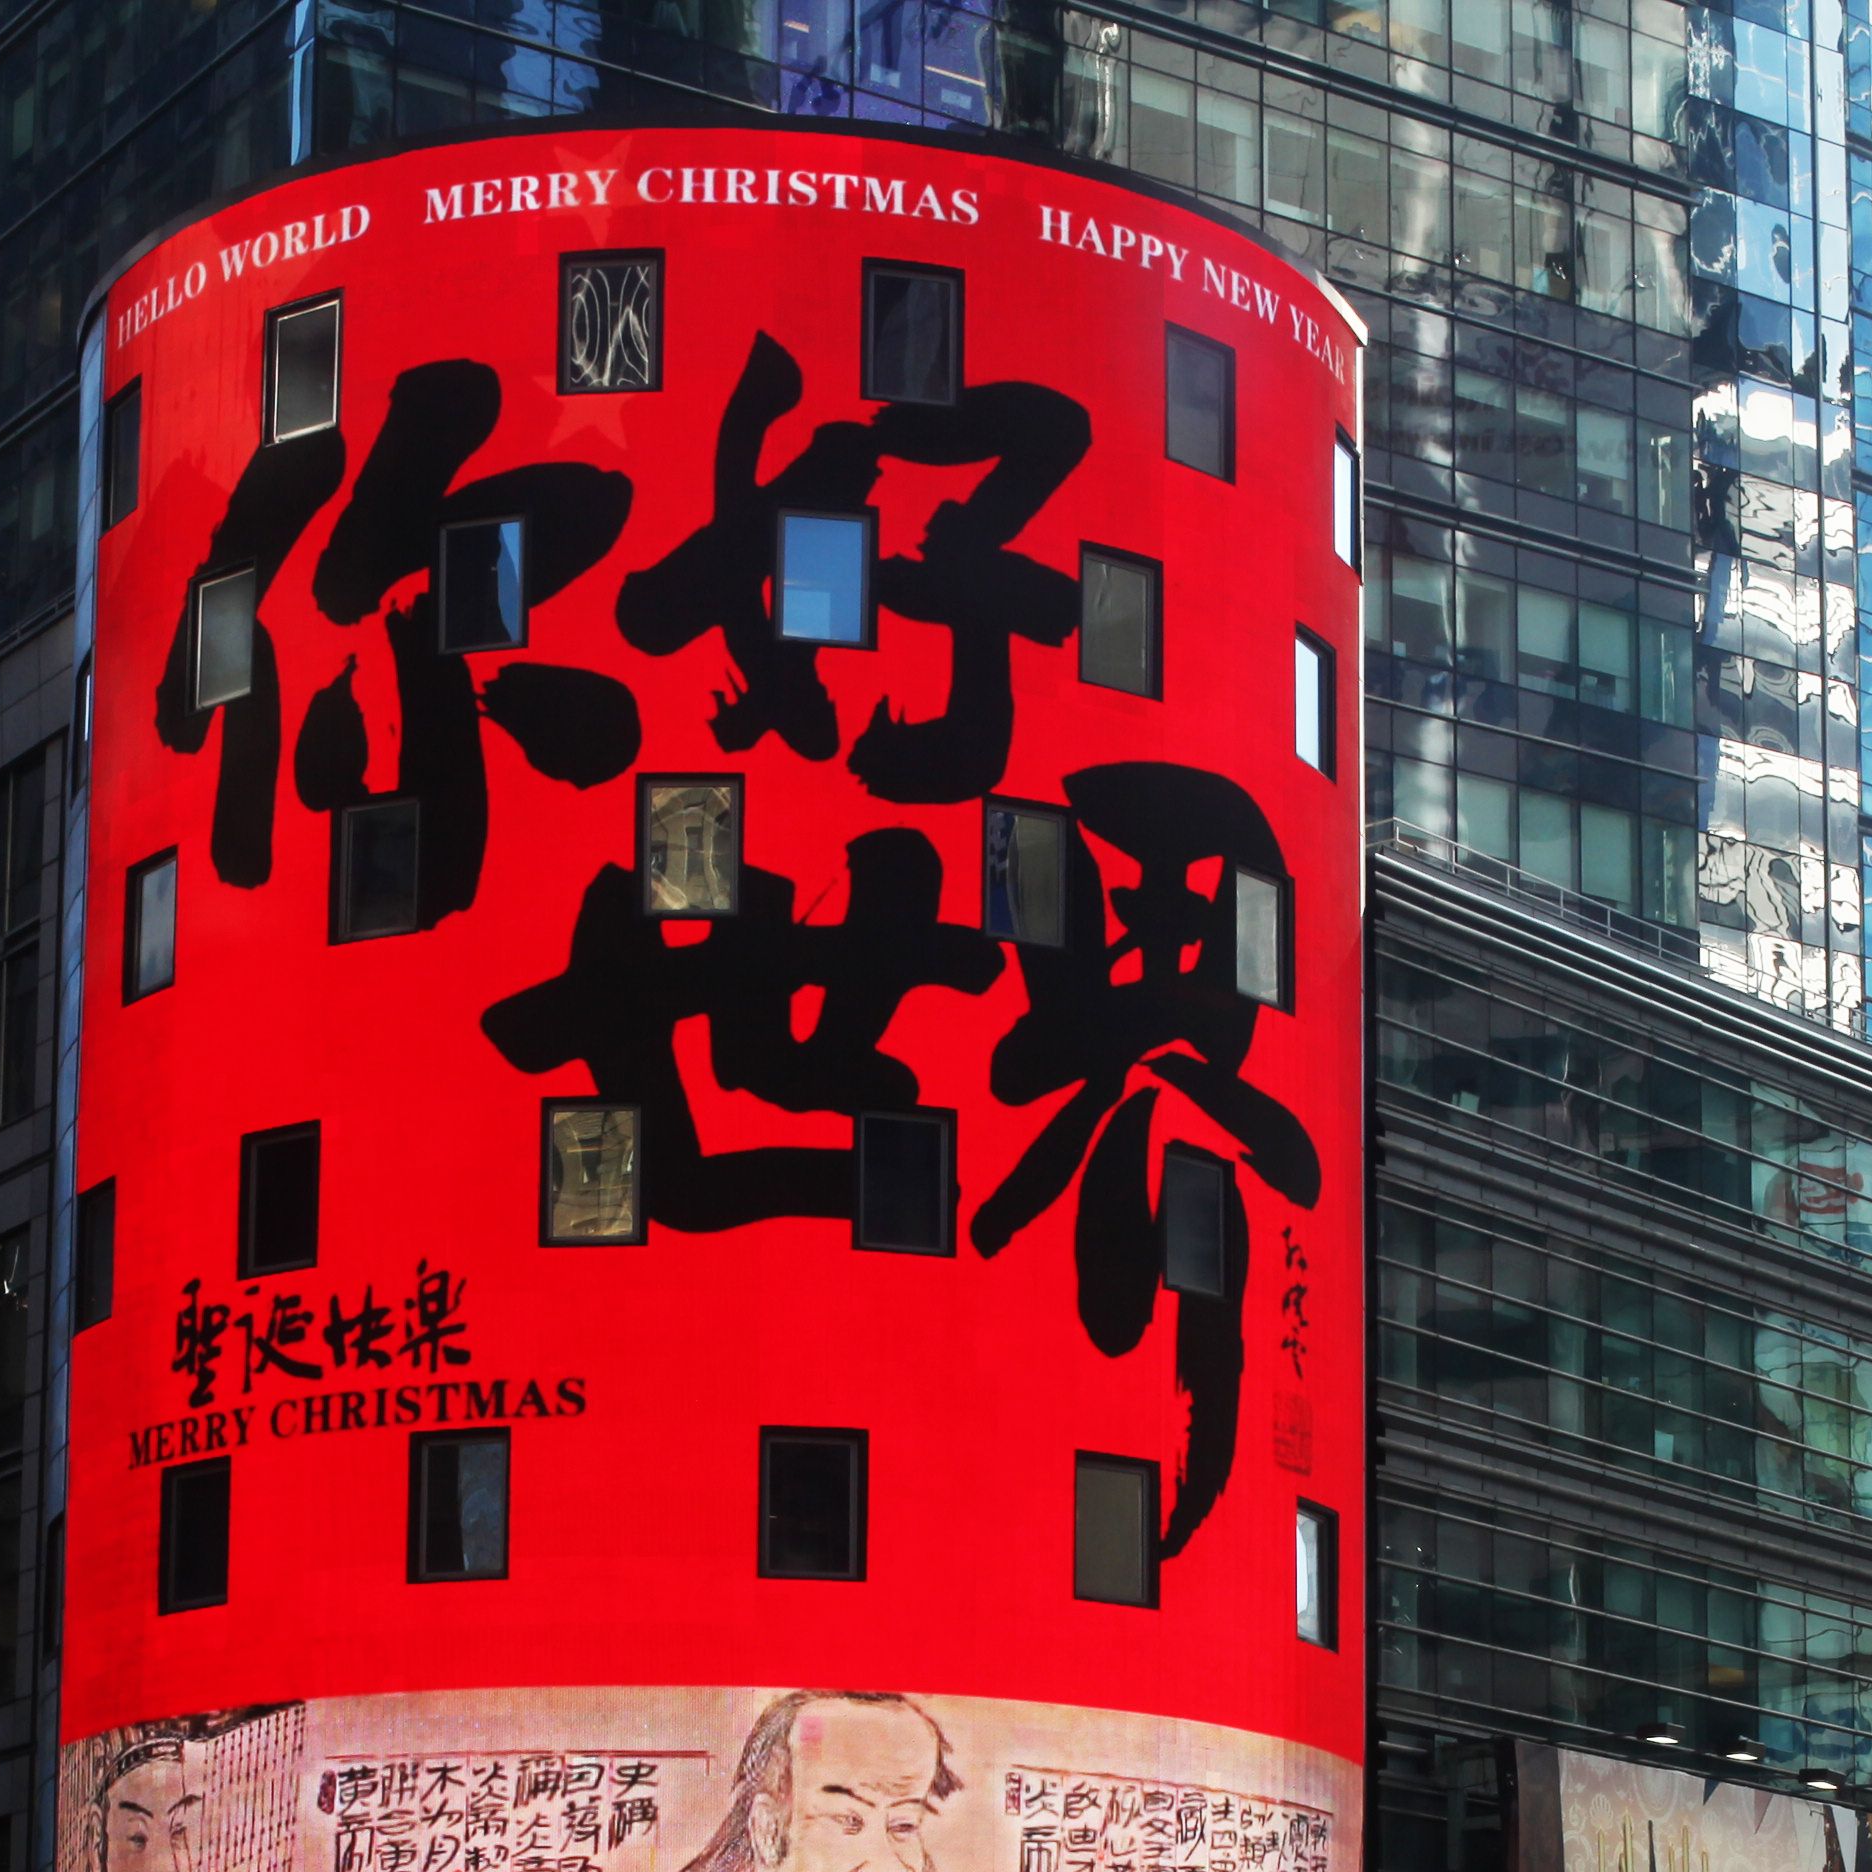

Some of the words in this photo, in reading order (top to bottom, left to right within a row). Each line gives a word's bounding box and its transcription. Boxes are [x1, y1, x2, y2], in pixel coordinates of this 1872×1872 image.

[117, 262, 206, 349] HELLO
[219, 204, 370, 281] WORLD
[424, 169, 618, 225] MERRY
[636, 166, 980, 226] CHRISTMAS
[1039, 205, 1190, 281] HAPPY
[1202, 257, 1280, 326] NEW
[1288, 303, 1346, 387] YEAR
[155, 331, 1092, 932] 你好
[481, 760, 1323, 1561] 世界
[129, 1406, 256, 1471] MERRY
[270, 1377, 587, 1440] CHRISTMAS
